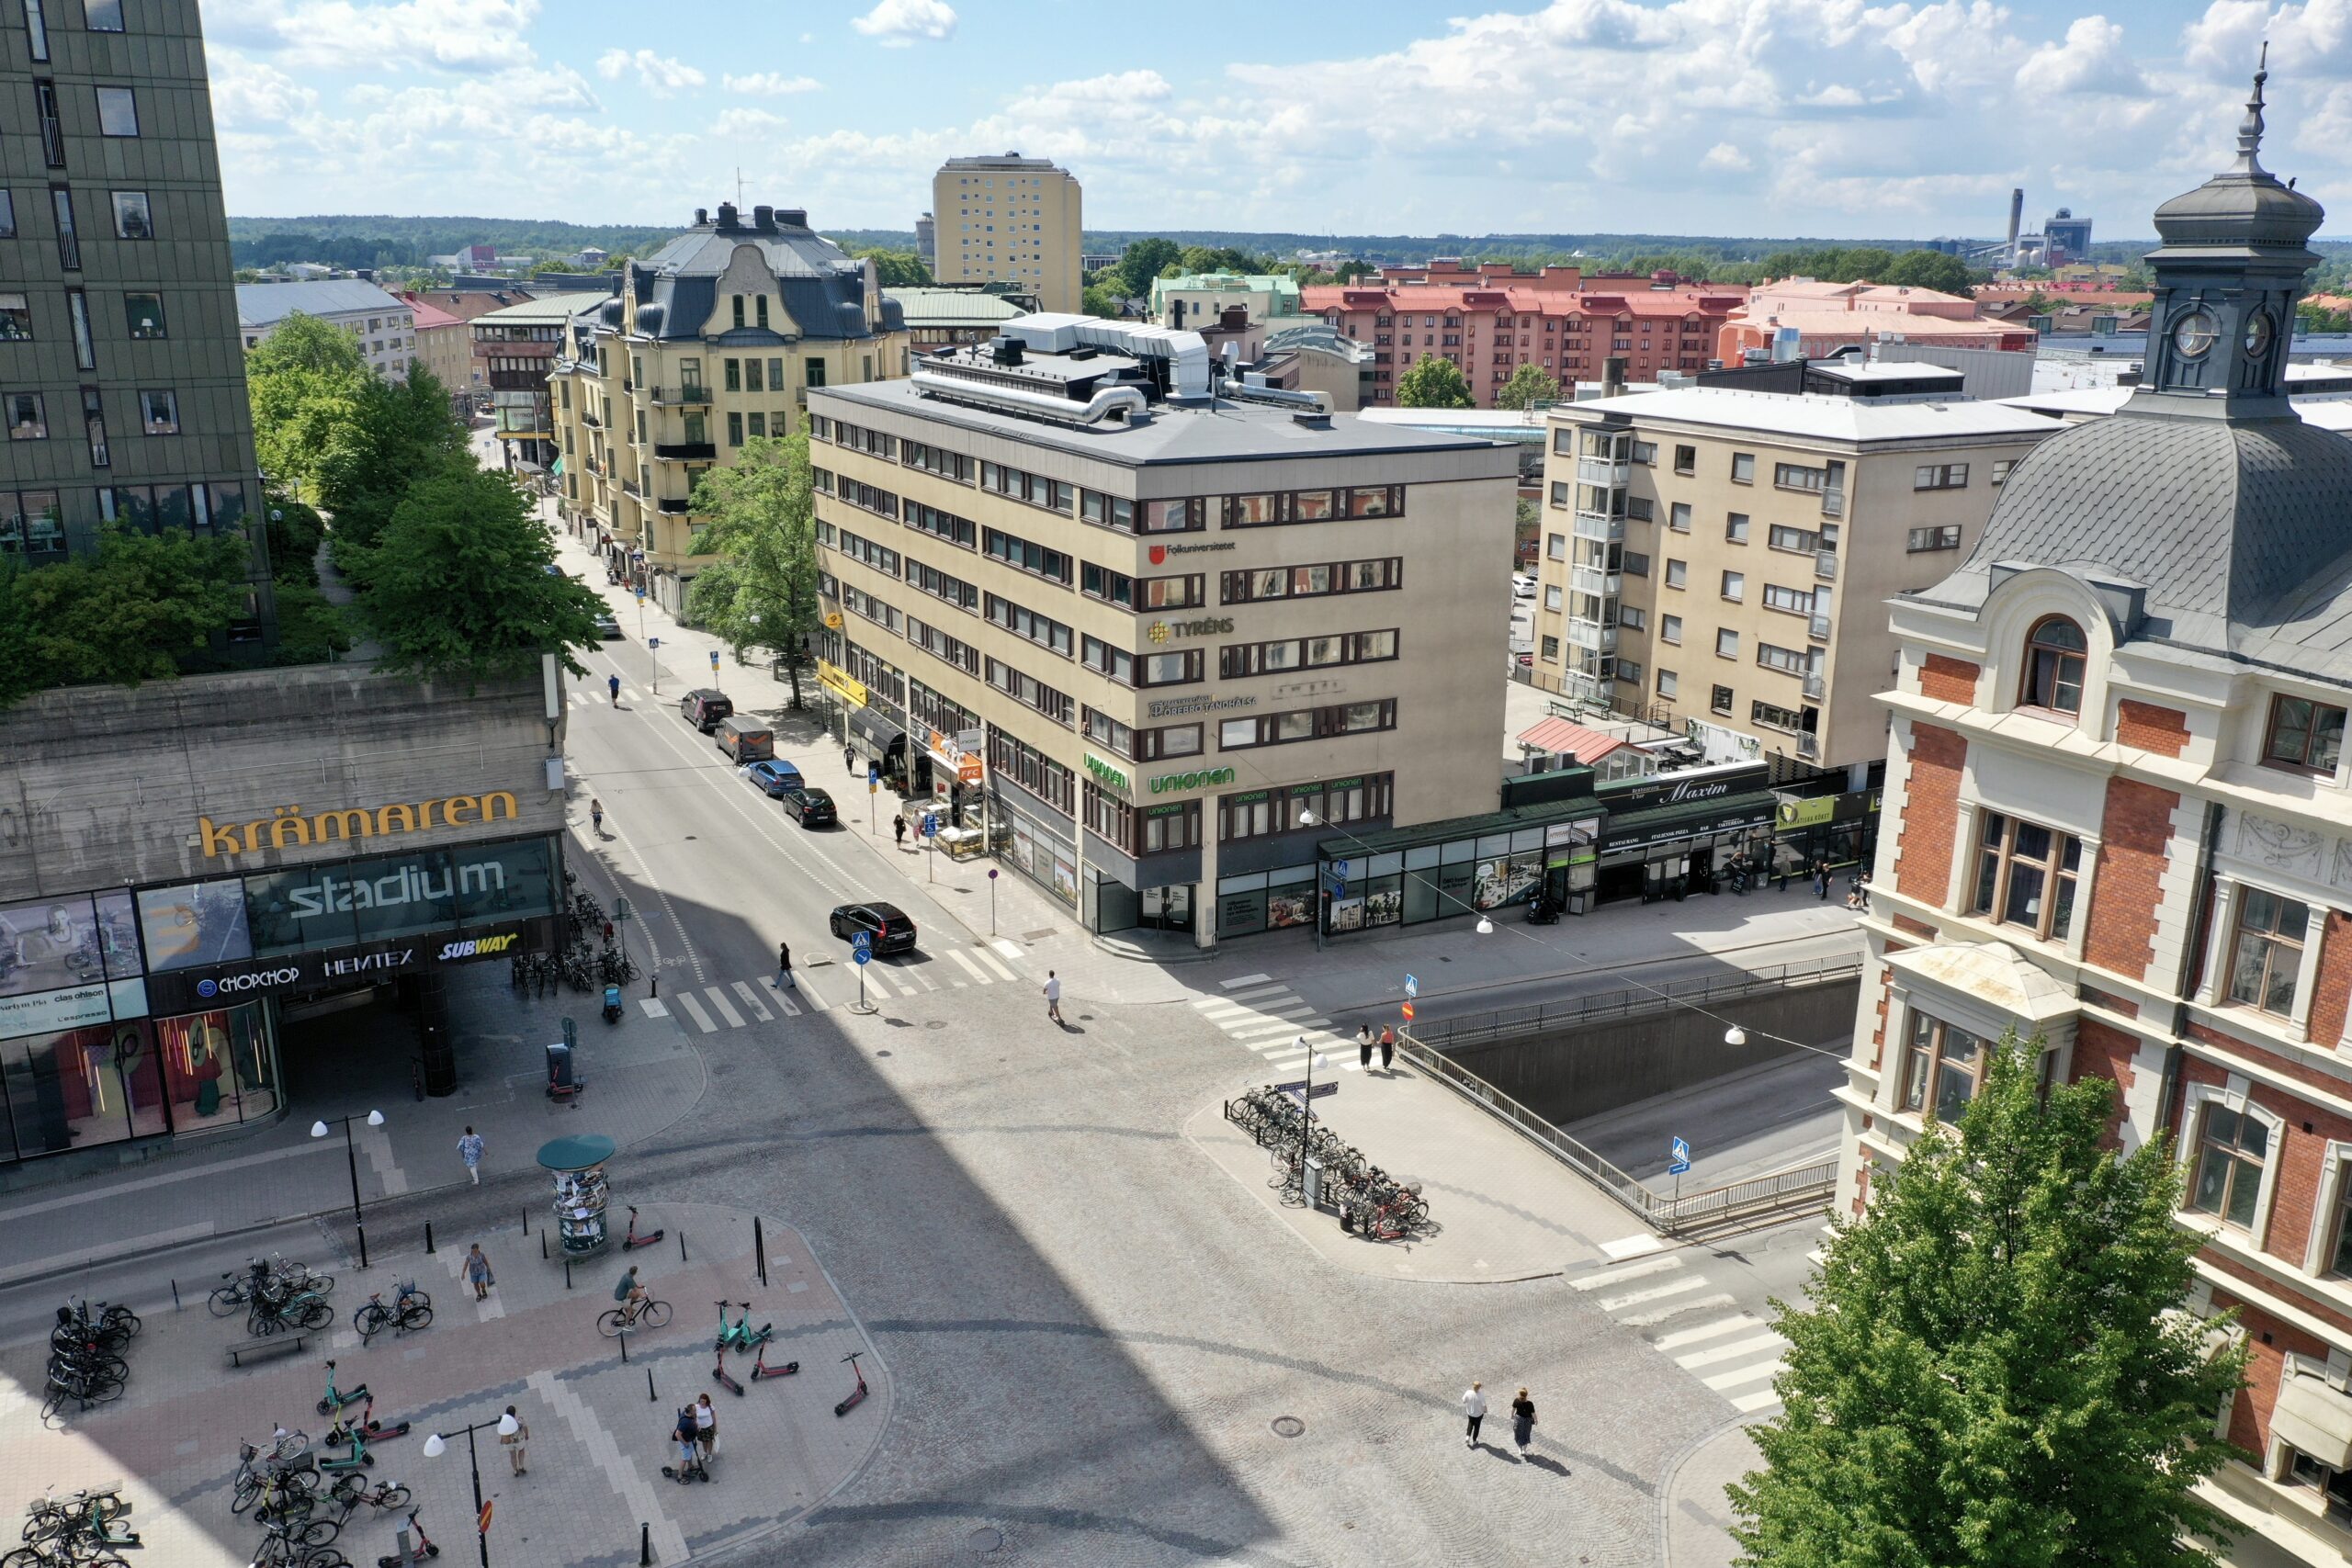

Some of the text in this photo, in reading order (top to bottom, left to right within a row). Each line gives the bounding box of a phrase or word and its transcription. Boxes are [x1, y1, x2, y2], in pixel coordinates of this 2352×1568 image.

[1167, 542, 1236, 554] Folkuniversitetet
[1172, 617, 1235, 637] TYRÉNS
[1164, 696, 1258, 716] ÖREBRO TANDHÄLSA
[961, 769, 979, 778] FFC
[1659, 780, 1728, 804] Maxim
[199, 791, 517, 857] krämaren
[1814, 813, 1830, 821] KÖKET
[1609, 837, 1639, 847] RESTAURANG
[1651, 830, 1675, 840] ITALIENSK
[288, 861, 504, 919] stadium
[438, 933, 517, 960] SUBWAY
[324, 949, 413, 977] HEMTEX
[219, 967, 300, 993] CHOPCHOP
[54, 992, 74, 1002] clas
[74, 989, 104, 999] ohlson
